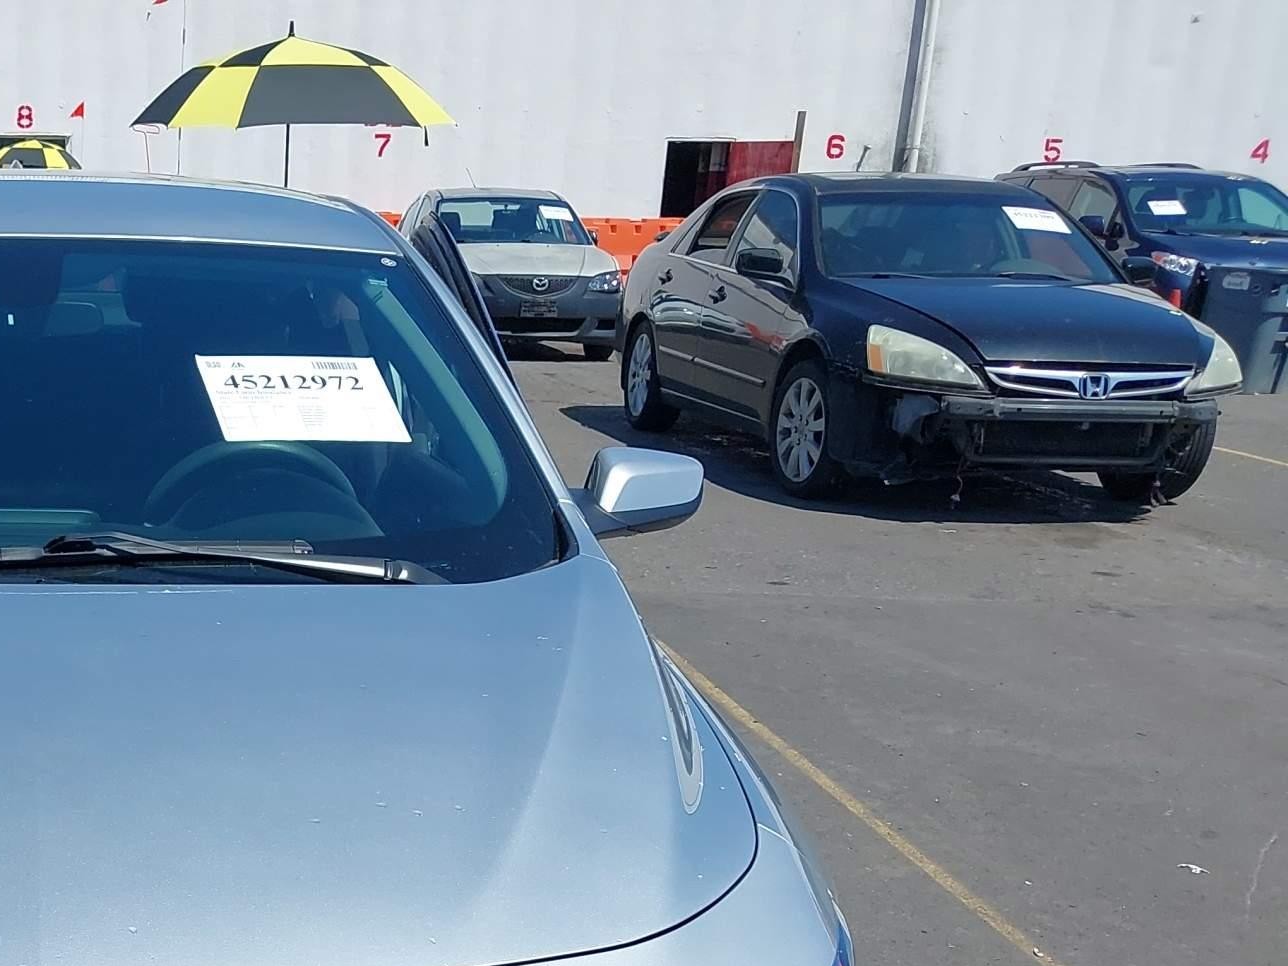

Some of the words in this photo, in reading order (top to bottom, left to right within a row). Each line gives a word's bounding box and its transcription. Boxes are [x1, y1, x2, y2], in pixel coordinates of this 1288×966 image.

[16, 105, 34, 129] 8
[374, 133, 392, 157] 7
[825, 134, 846, 160] 6
[1044, 138, 1063, 163] 5
[1250, 139, 1270, 164] 4
[223, 374, 364, 391] 45212972
